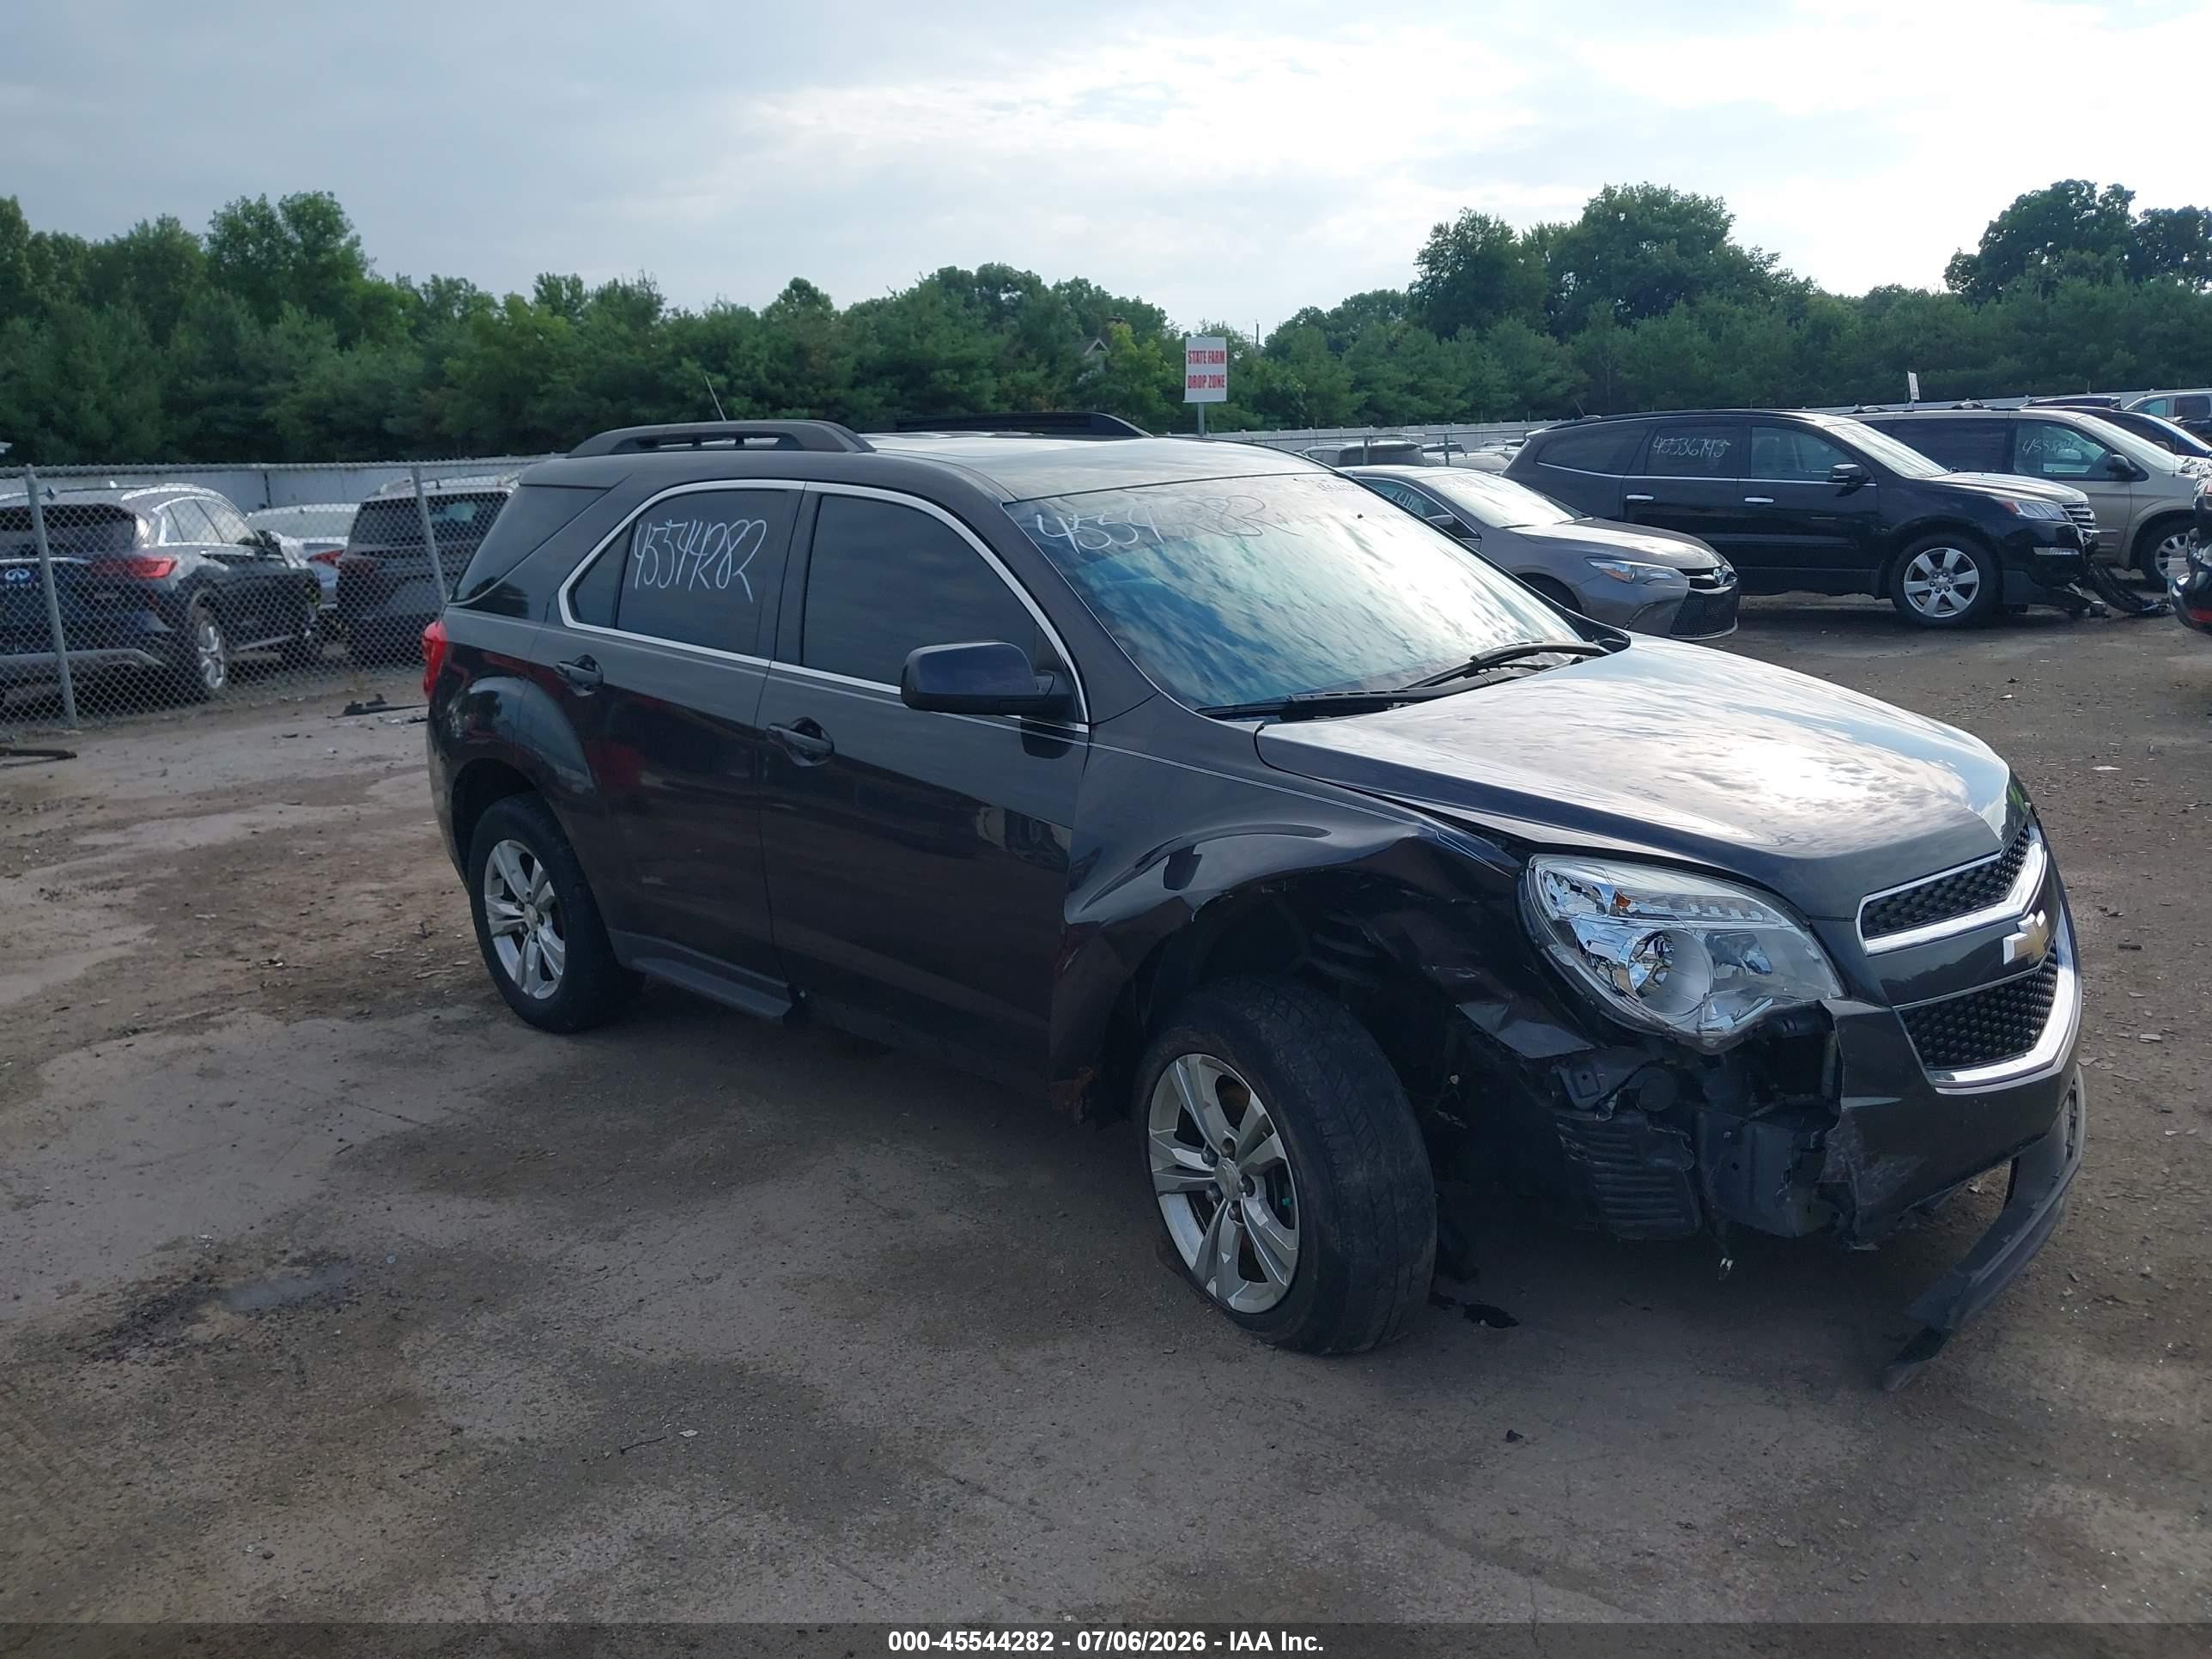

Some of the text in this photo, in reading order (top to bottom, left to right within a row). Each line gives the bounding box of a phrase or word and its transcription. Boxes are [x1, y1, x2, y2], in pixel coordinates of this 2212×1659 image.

[1188, 350, 1225, 364] STATE FARM
[1188, 374, 1225, 389] DROP ZONE
